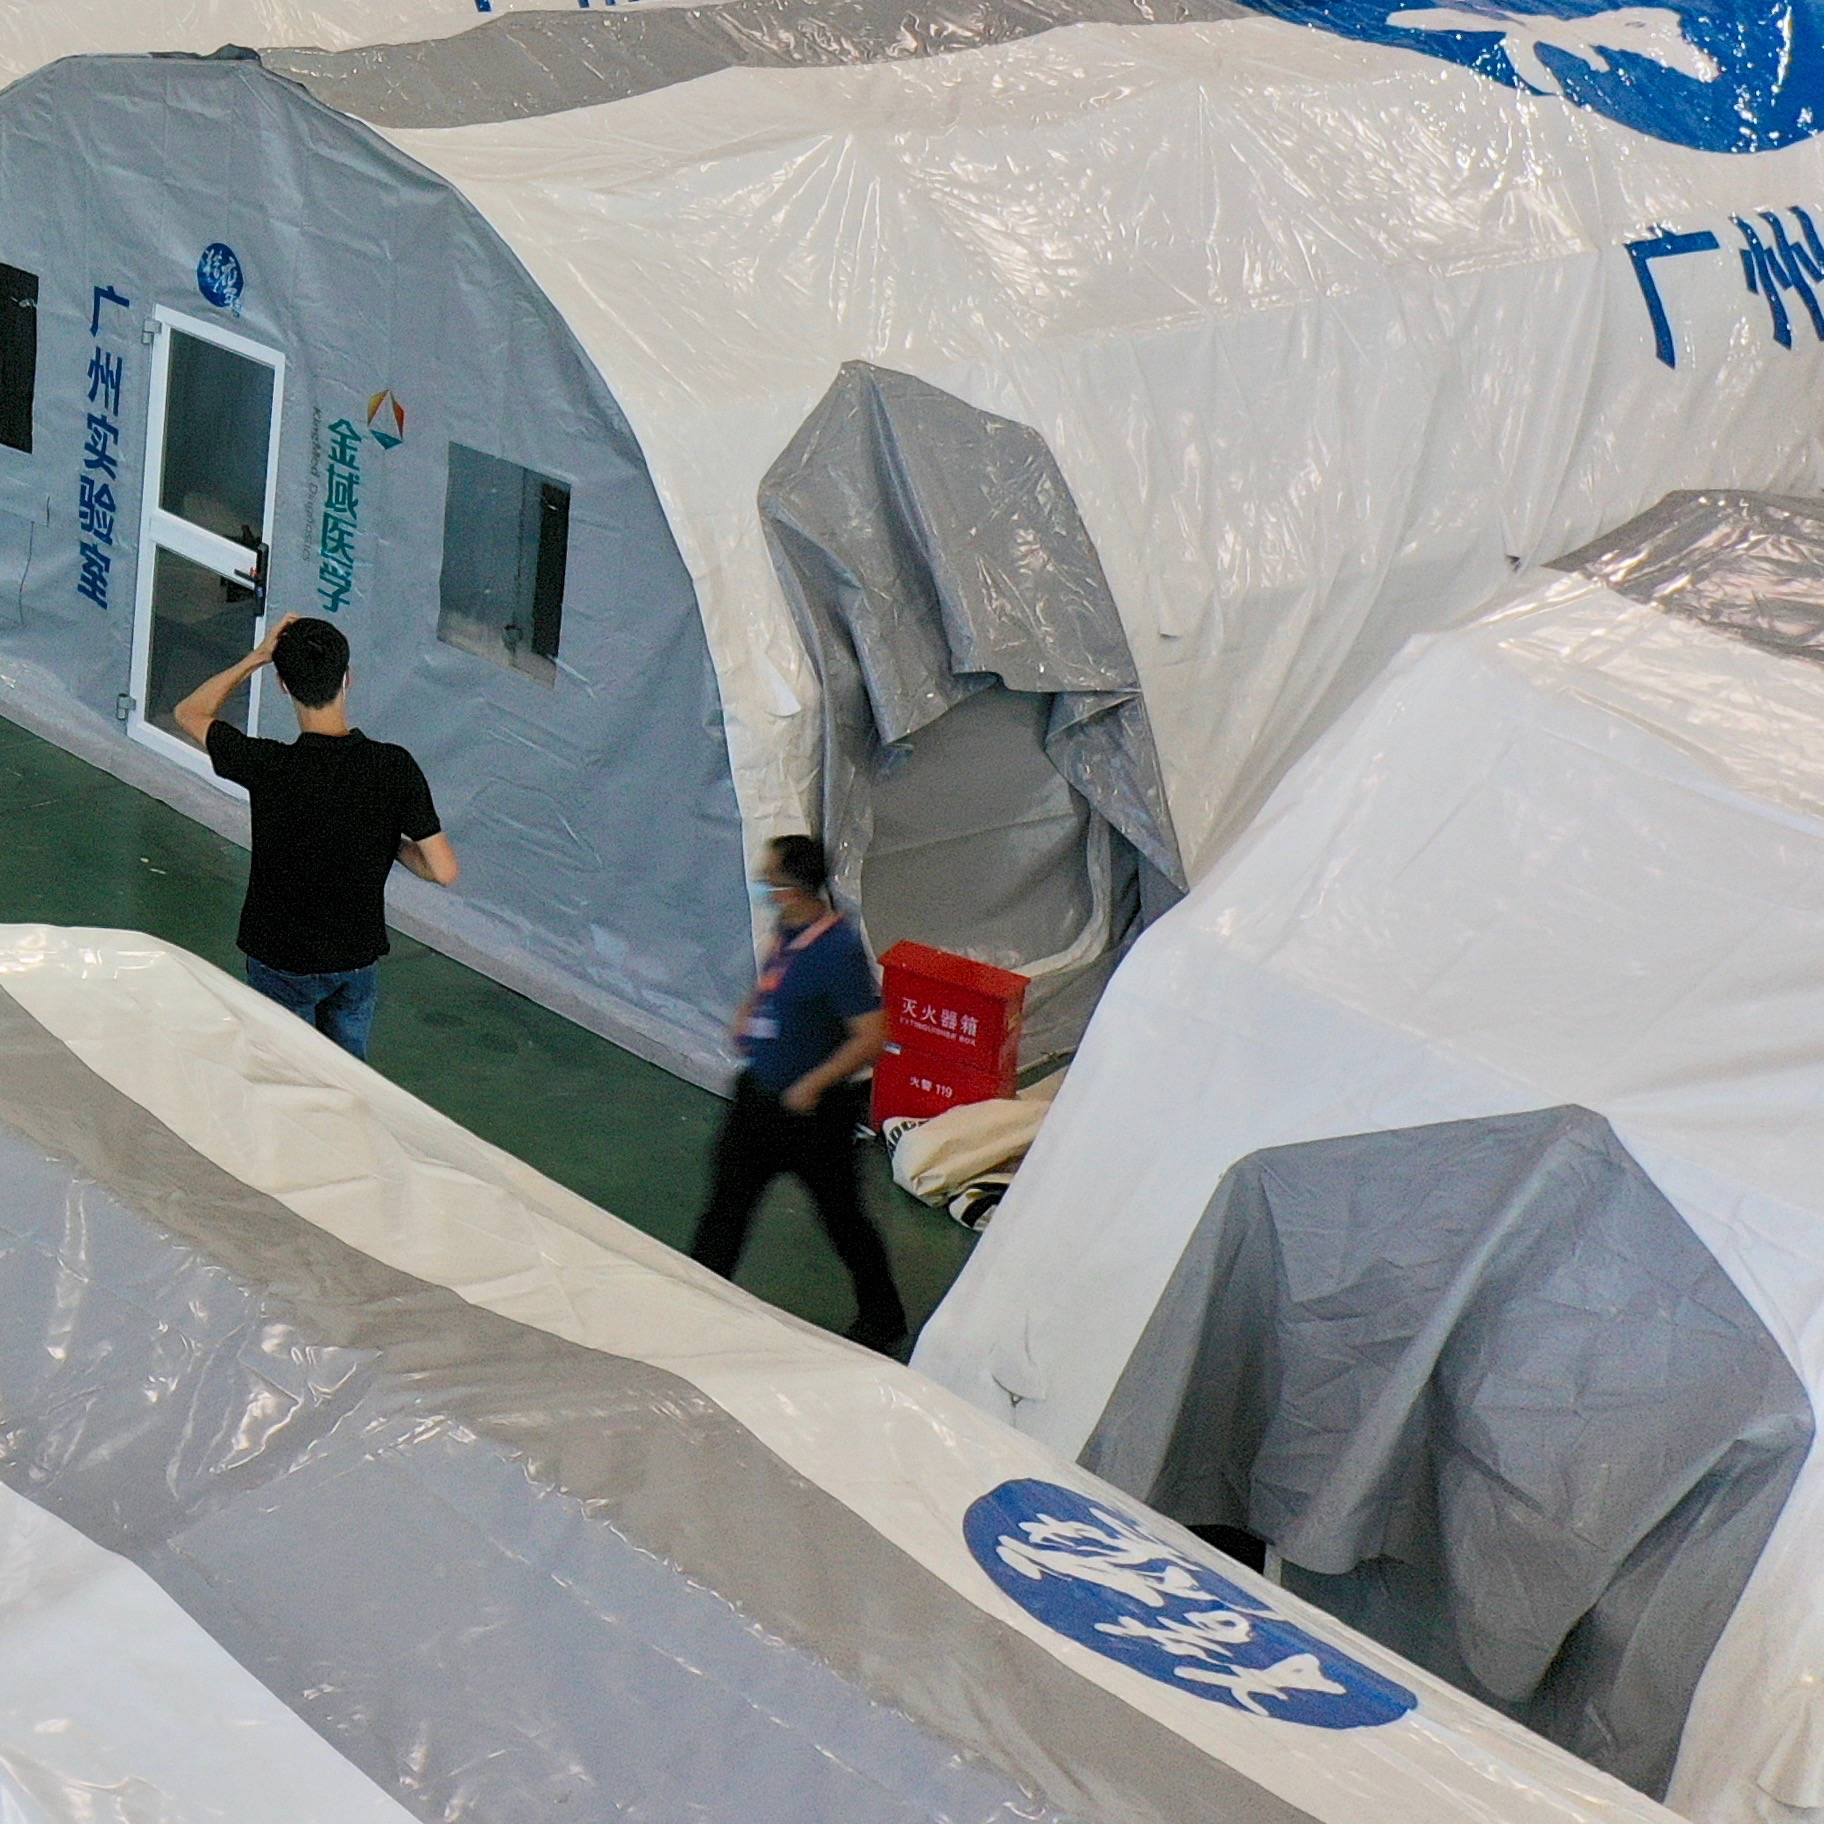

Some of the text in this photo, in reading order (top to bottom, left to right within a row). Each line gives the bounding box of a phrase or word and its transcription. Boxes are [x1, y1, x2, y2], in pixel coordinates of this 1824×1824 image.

[77, 285, 130, 610] 广州实验室
[318, 418, 362, 613] 金域医学
[902, 996, 979, 1038] 灭火器箱
[958, 1033, 977, 1048] BOX
[910, 1076, 953, 1099] 火警 119
